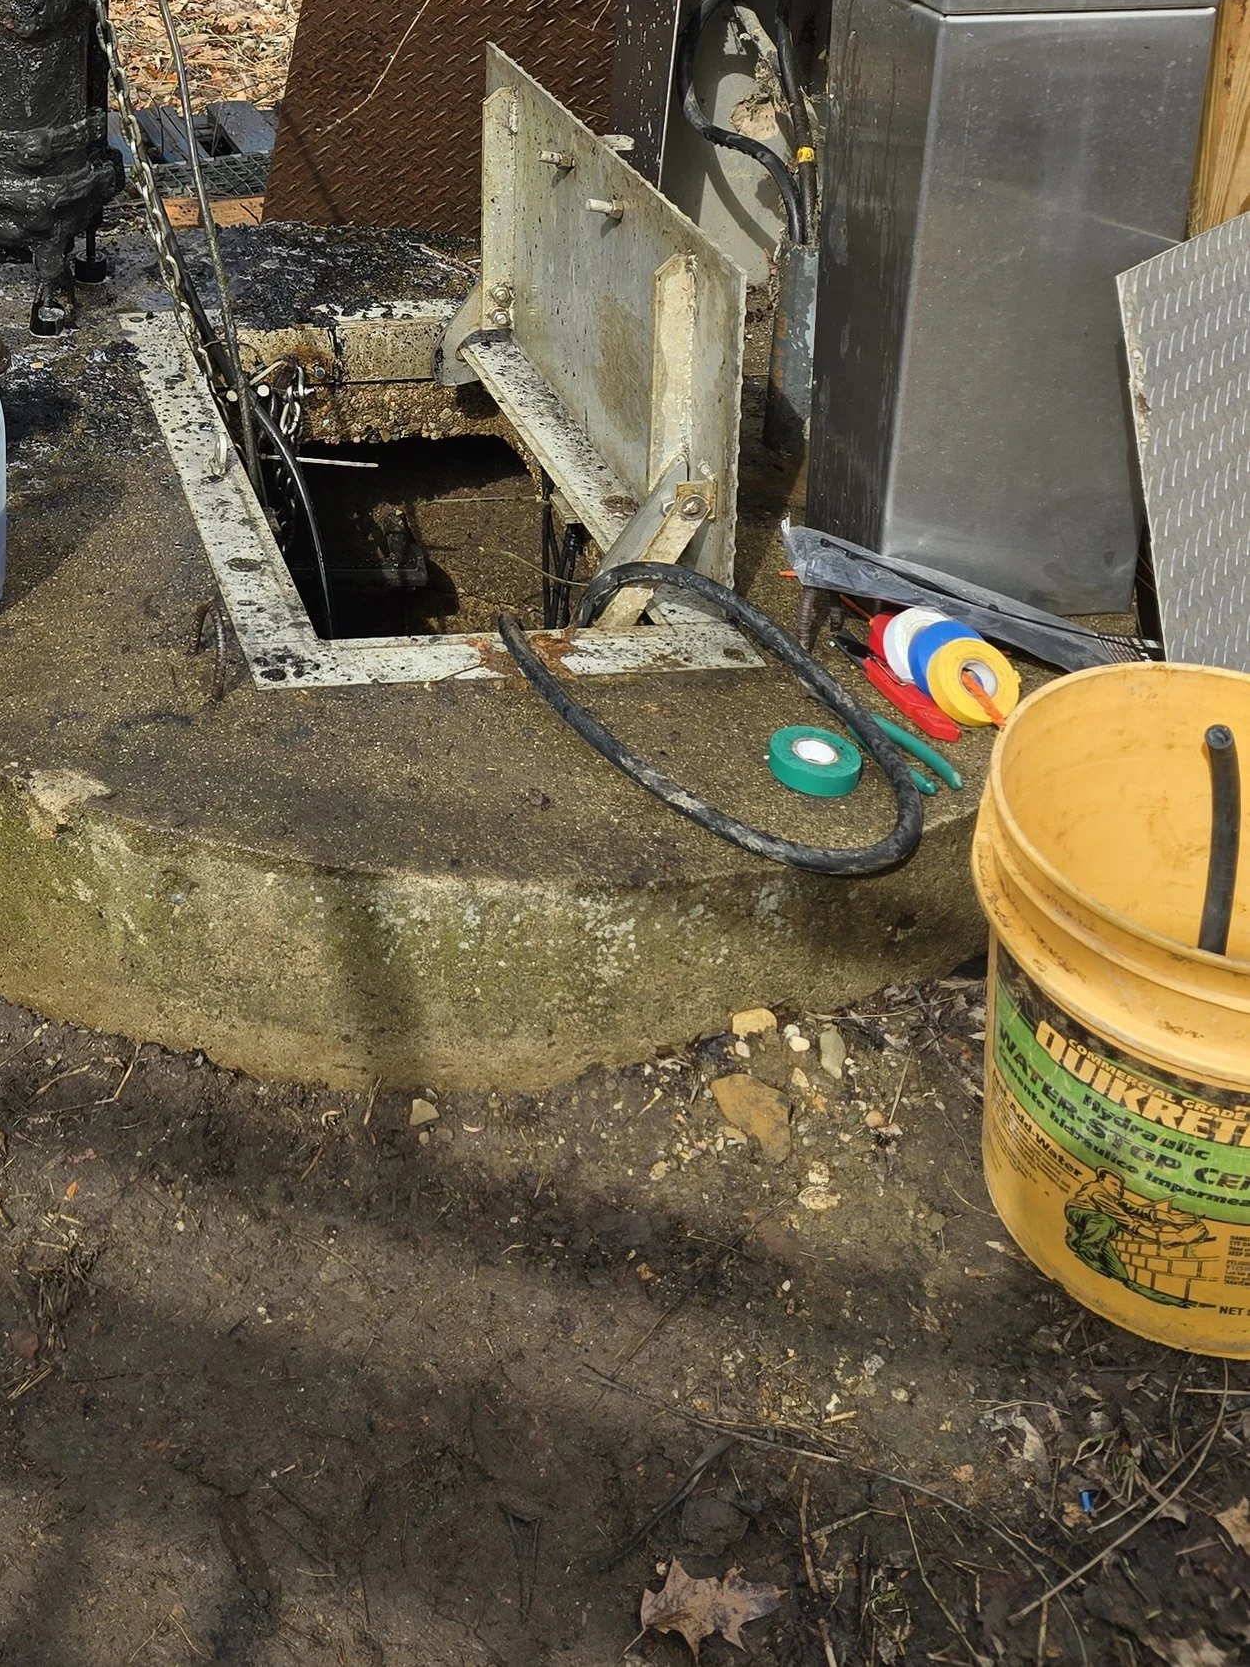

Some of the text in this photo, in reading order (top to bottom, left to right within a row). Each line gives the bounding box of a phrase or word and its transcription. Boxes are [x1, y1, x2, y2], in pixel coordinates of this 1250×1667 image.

[1068, 1038, 1247, 1122] COMMERCIAL GRADE
[1082, 1094, 1211, 1161] Hydraulic
[1219, 1305, 1245, 1316] NET
